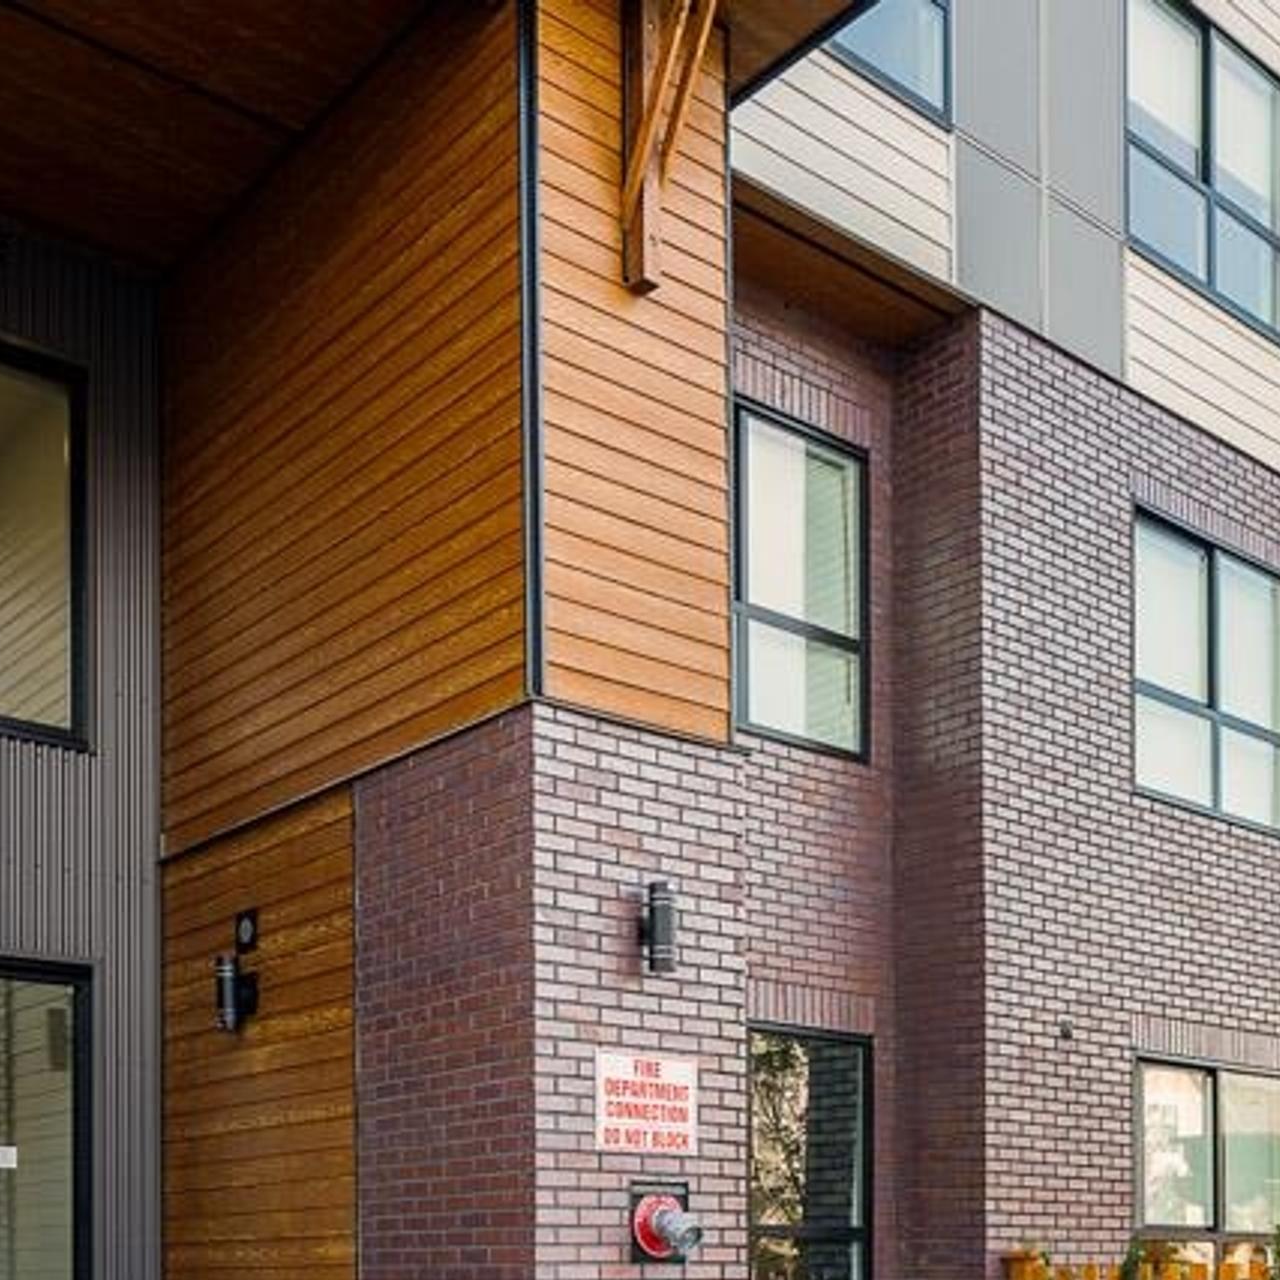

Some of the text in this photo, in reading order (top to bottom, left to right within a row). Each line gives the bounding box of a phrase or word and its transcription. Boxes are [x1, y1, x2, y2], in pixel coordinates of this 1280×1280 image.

[634, 1059, 661, 1078] FIRE
[604, 1077, 689, 1102] DEPARTMENT
[606, 1100, 689, 1123] CONNECTION
[604, 1127, 689, 1150] DO NOT BLOCK
